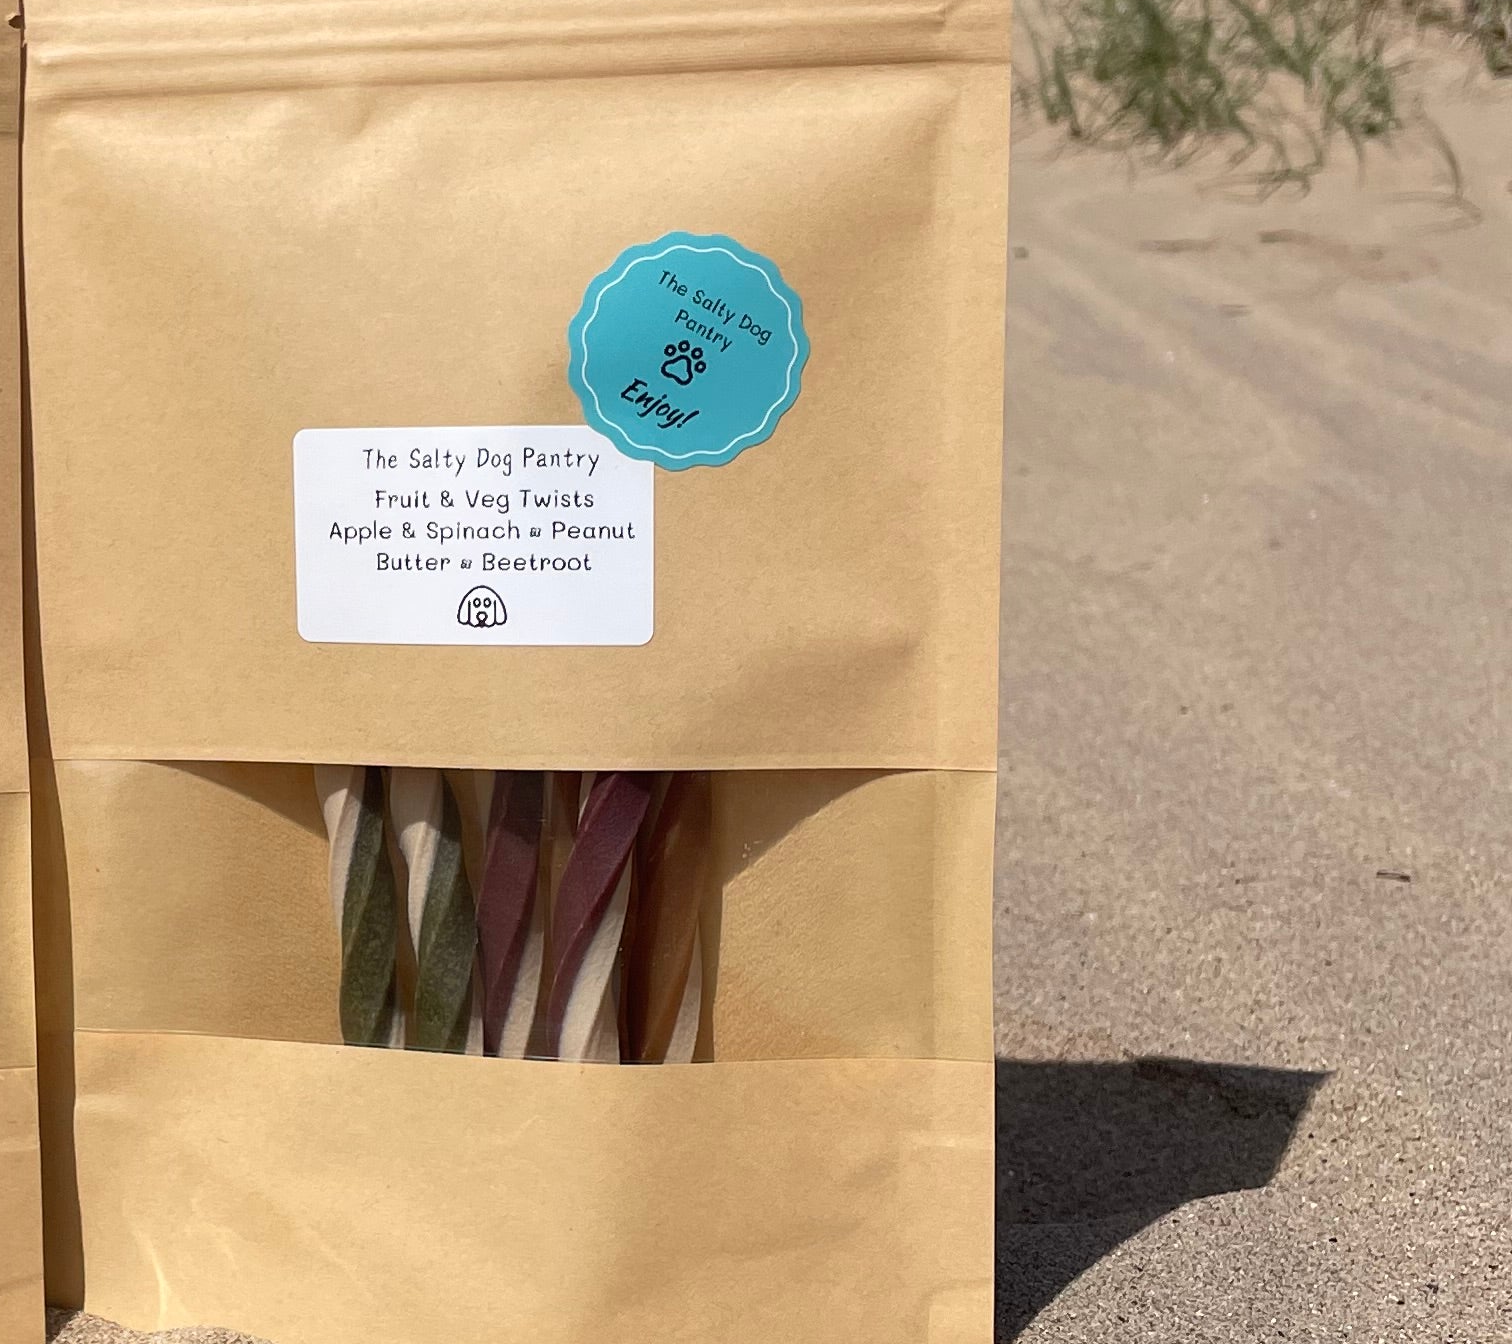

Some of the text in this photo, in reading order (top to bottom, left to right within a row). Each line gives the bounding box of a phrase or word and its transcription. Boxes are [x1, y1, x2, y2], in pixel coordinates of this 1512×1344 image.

[657, 270, 773, 346] The Salty Dog
[675, 309, 733, 353] Pantry
[620, 378, 700, 429] Enjoy!
[362, 446, 600, 478] The Salty Dog Pantry
[375, 489, 594, 515] Fruit & Veg Twists
[329, 519, 392, 545] Apple
[402, 521, 416, 539] &
[426, 519, 521, 545] Spinach
[551, 520, 636, 540] Peanut
[376, 552, 451, 571] Butter
[482, 552, 592, 572] Beetroot
